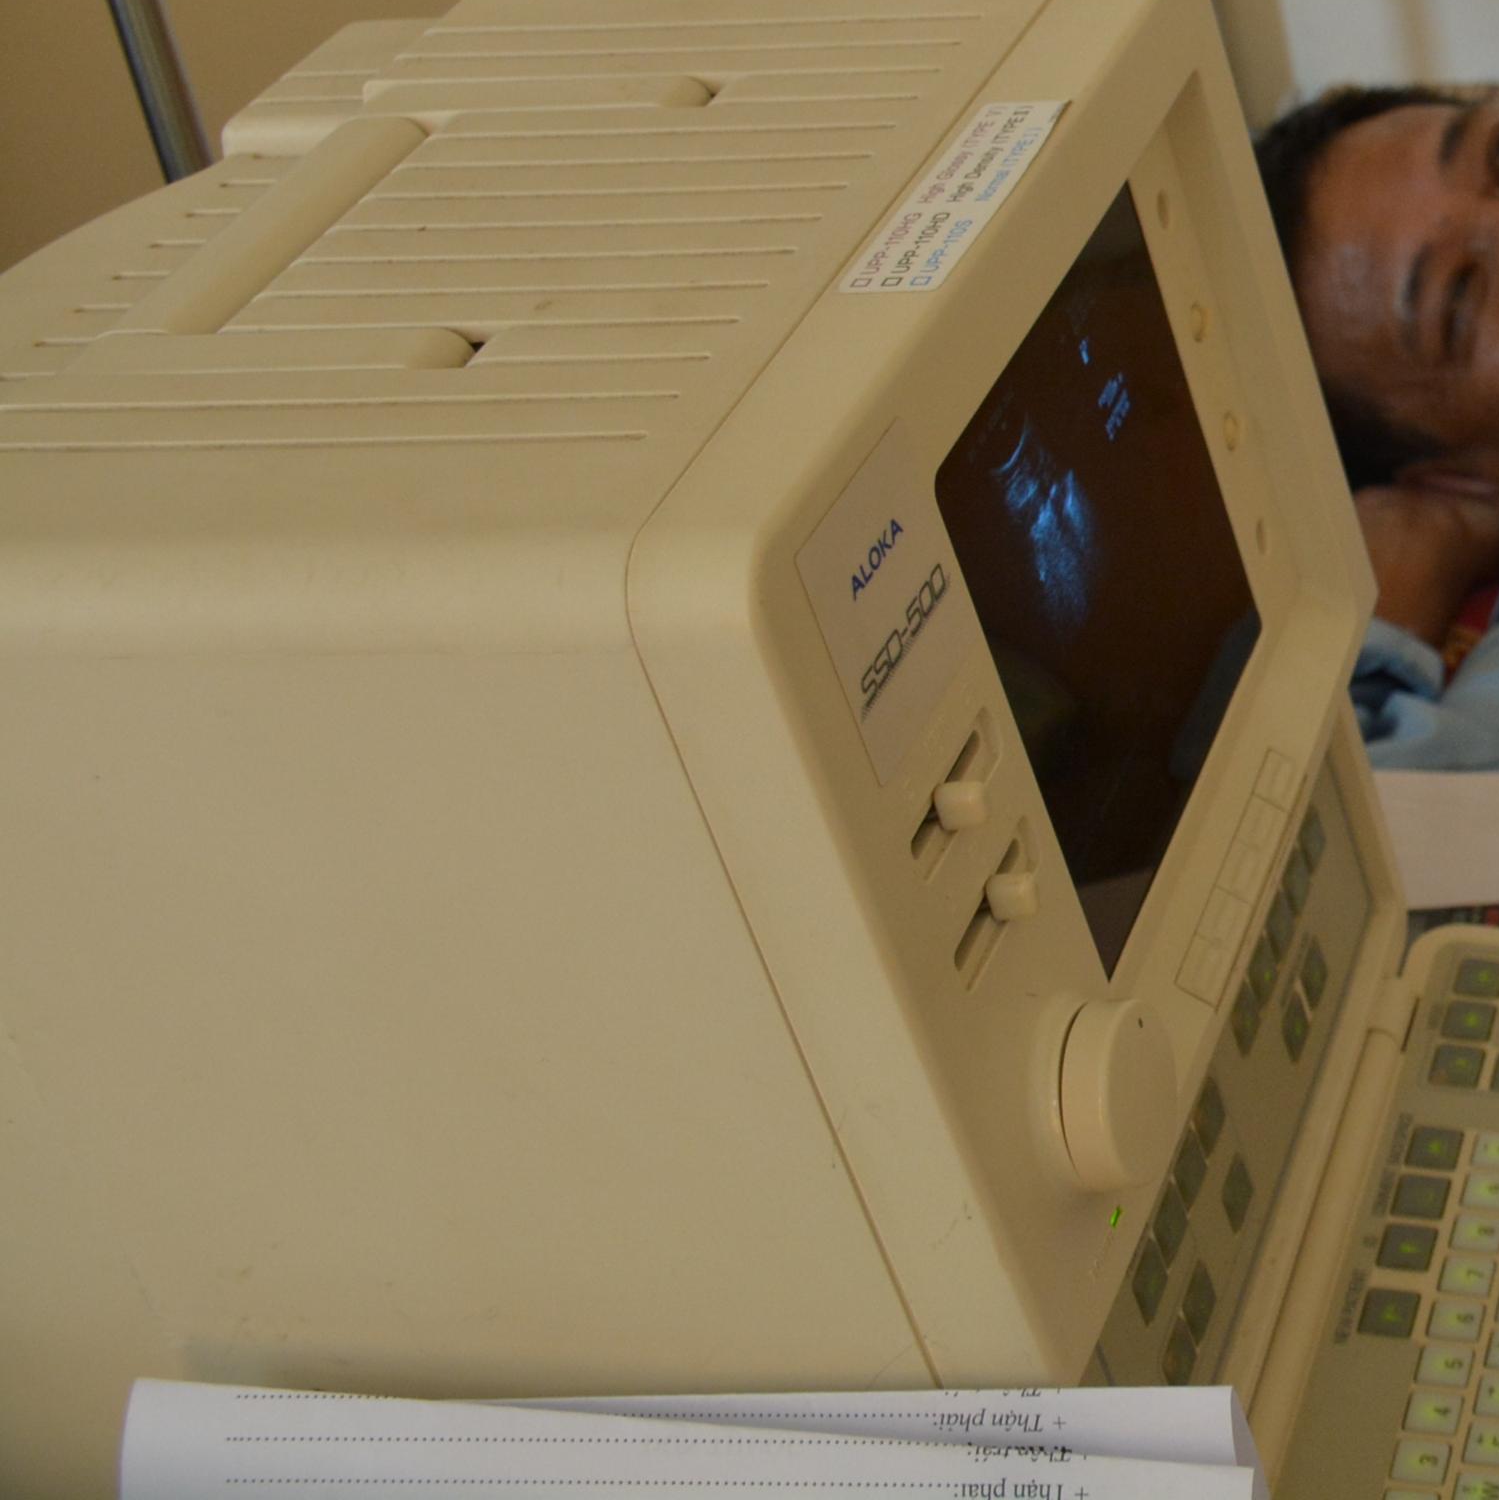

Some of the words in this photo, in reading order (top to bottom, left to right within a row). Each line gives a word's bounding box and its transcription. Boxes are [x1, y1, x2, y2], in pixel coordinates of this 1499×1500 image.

[946, 182, 974, 203] High
[851, 518, 904, 601] ALOKA
[861, 563, 946, 710] SSD-500
[991, 1409, 1043, 1433] Thận
